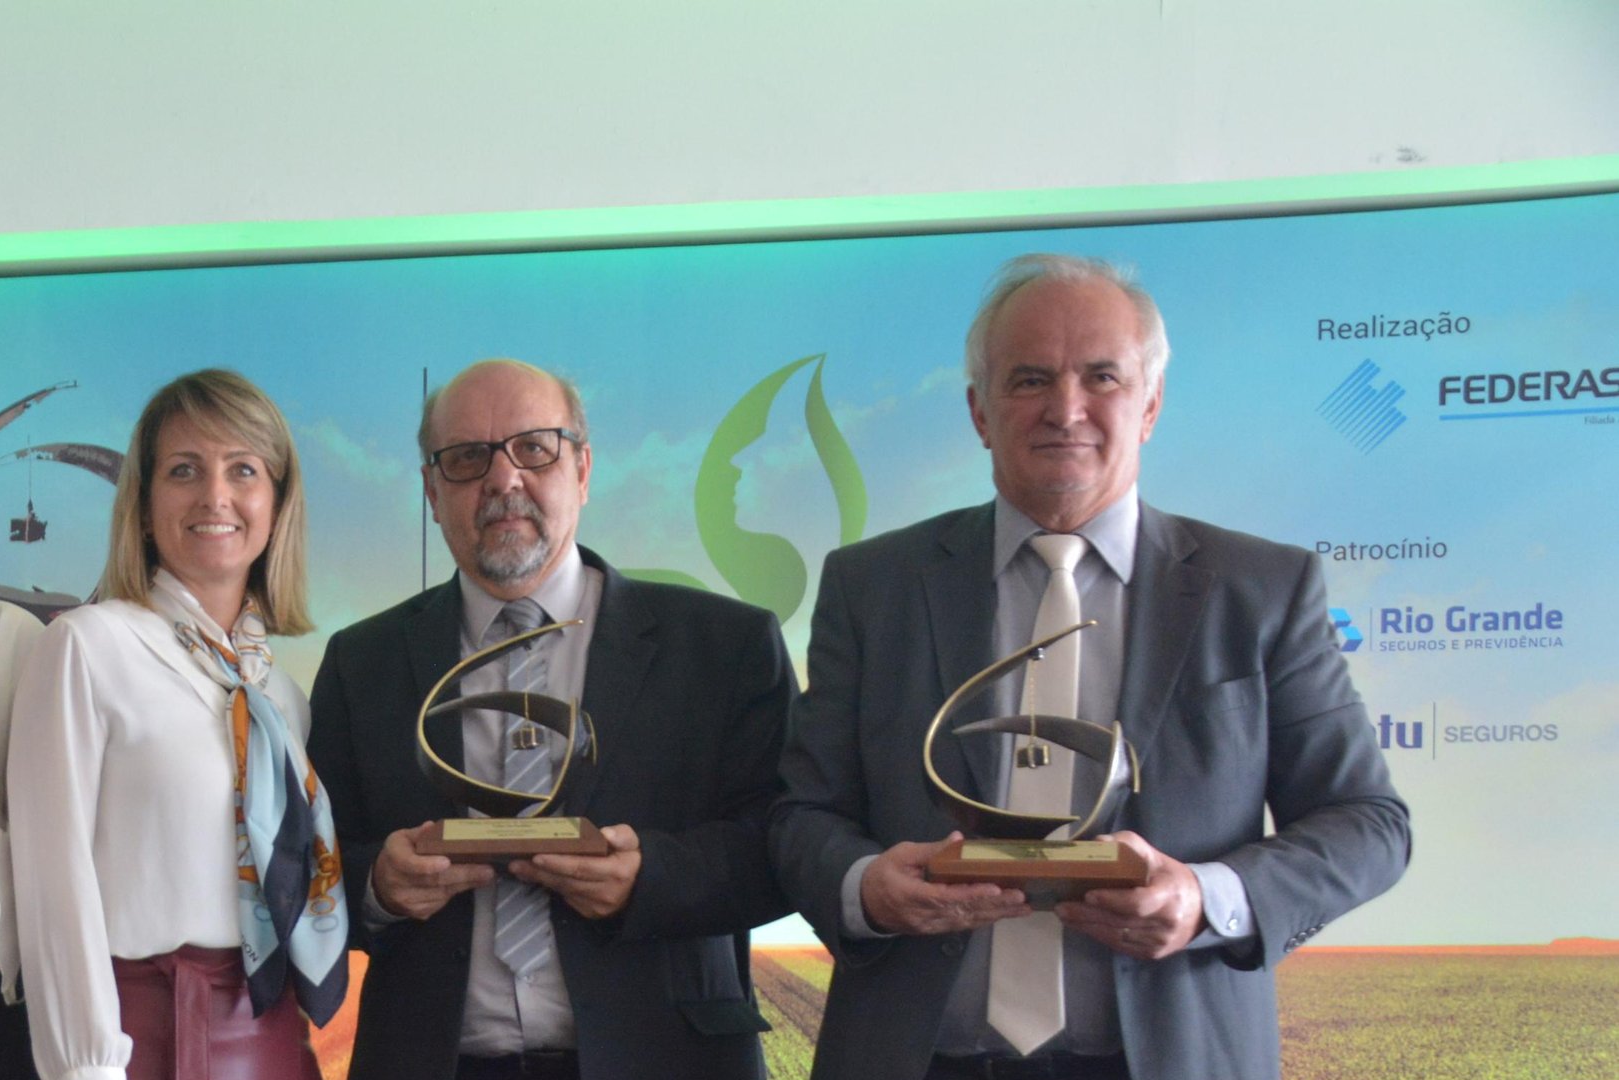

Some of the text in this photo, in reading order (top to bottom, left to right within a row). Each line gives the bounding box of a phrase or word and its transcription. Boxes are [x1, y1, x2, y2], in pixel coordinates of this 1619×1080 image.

[1317, 311, 1471, 341] Realização
[1316, 537, 1448, 562] Patrocínio
[1381, 602, 1564, 634] Rio Grande
[1380, 635, 1564, 652] SEGUROS E PREVIDÊNCIA
[1372, 714, 1559, 750] tu SEGUROS
